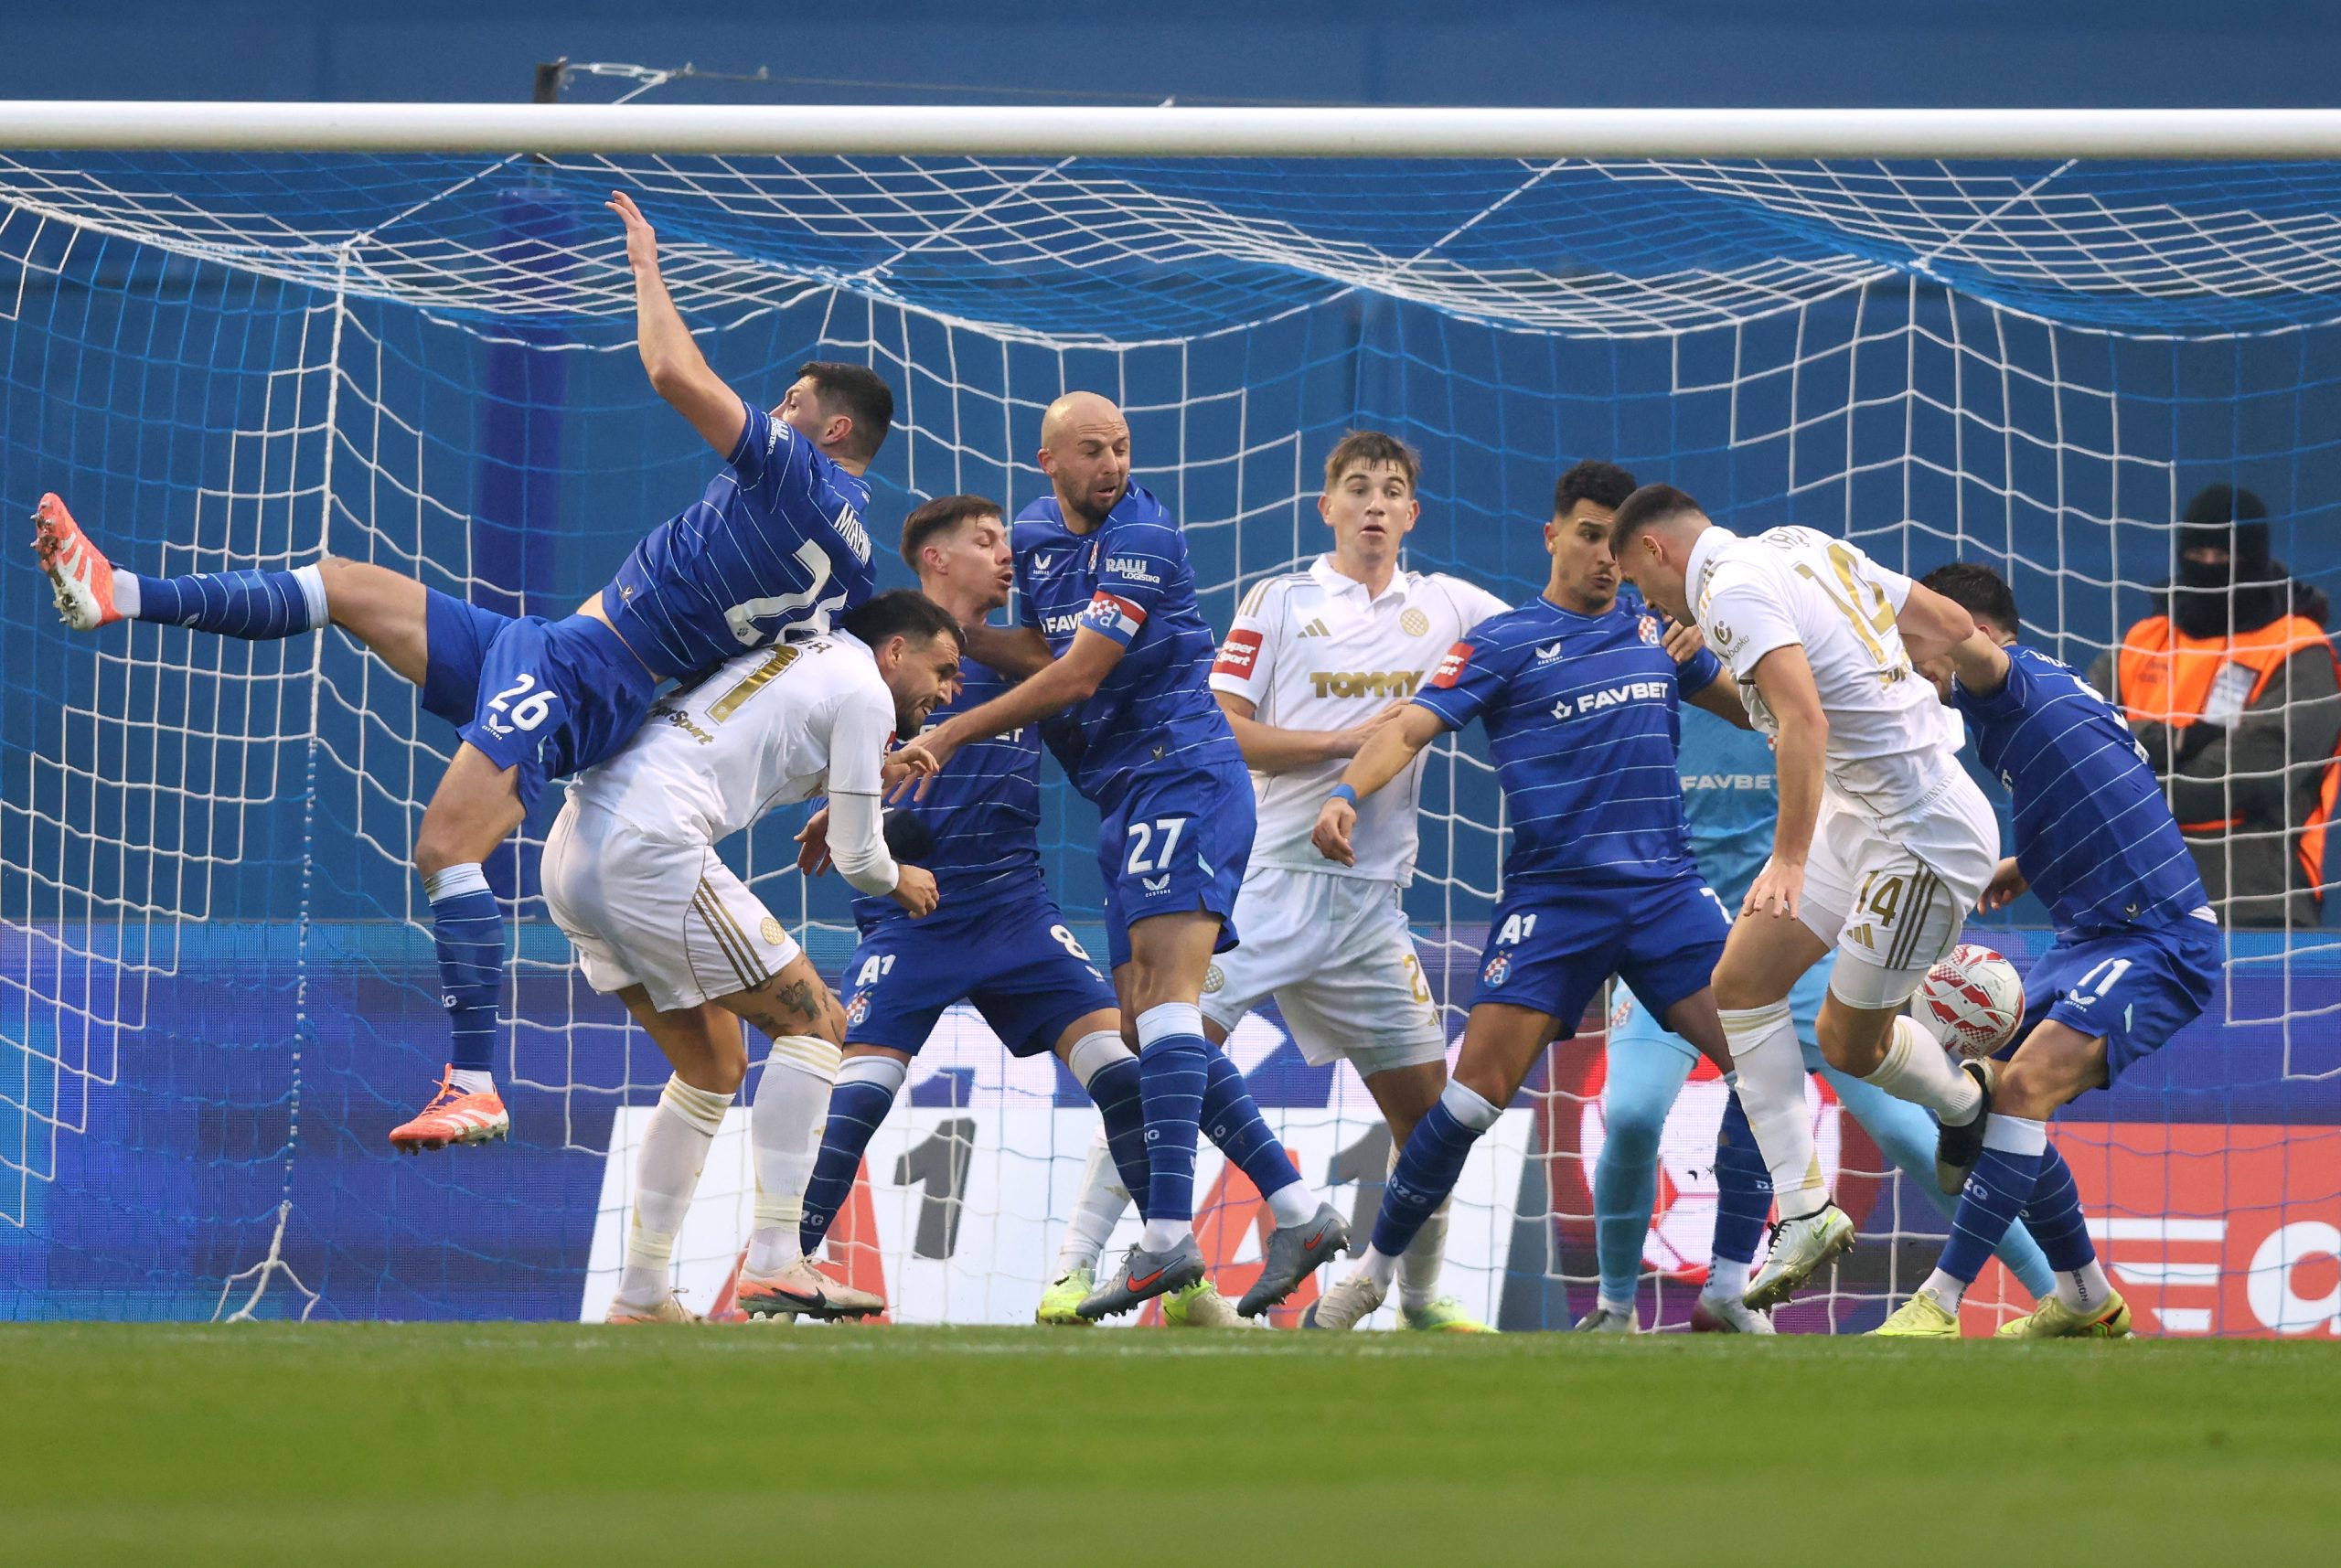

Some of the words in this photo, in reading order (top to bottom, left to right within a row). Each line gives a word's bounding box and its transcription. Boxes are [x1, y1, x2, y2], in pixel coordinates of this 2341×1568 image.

[1105, 558, 1148, 575] RALU
[1309, 671, 1425, 699] TOMMY
[1577, 682, 1668, 713] FAVBET
[487, 673, 559, 731] 26
[1128, 817, 1187, 875] 27
[1855, 869, 1904, 928] 14
[1050, 924, 1091, 961] 8
[1495, 913, 1537, 944] A1
[855, 954, 896, 987] A1
